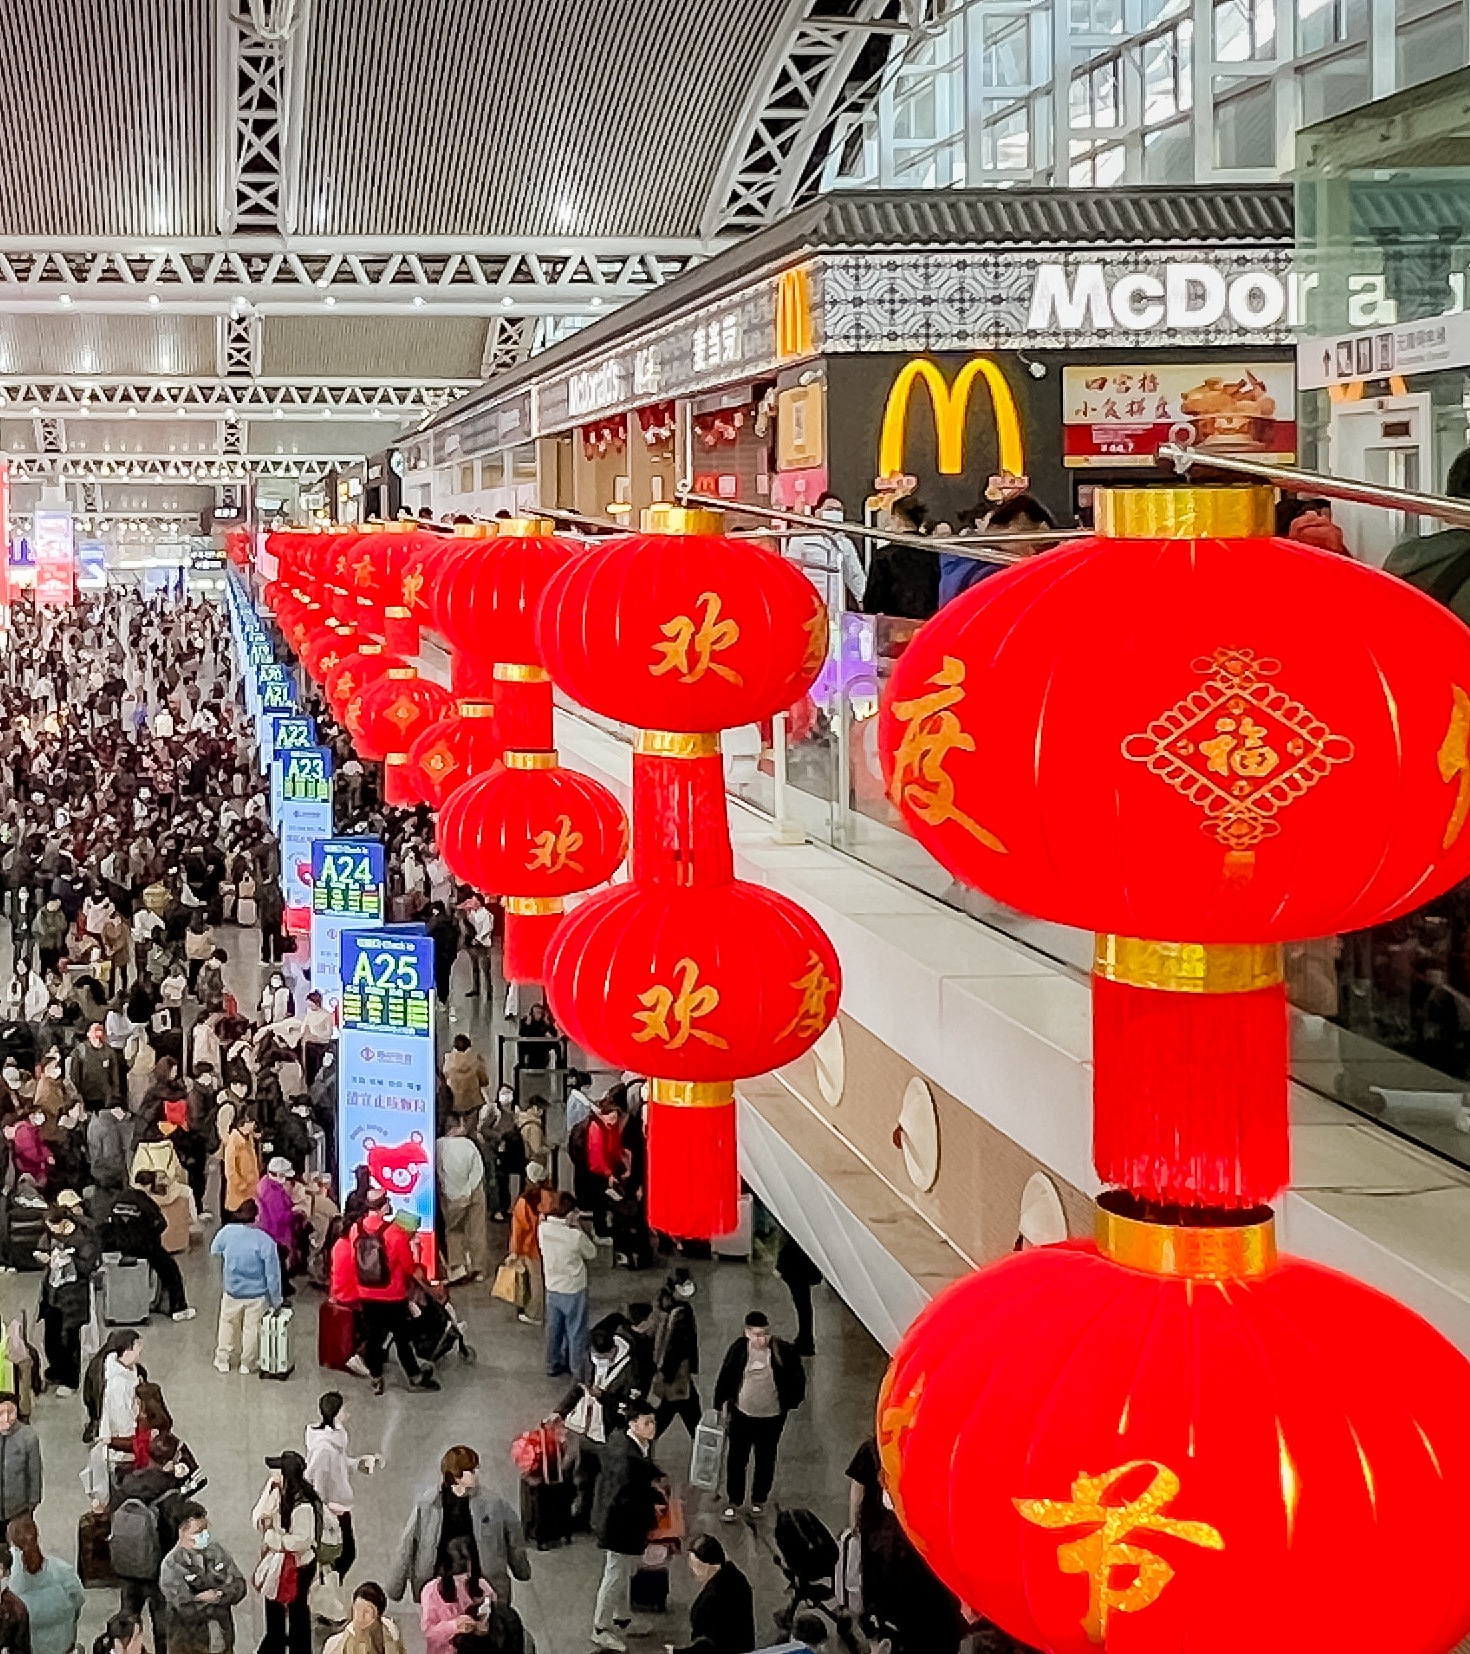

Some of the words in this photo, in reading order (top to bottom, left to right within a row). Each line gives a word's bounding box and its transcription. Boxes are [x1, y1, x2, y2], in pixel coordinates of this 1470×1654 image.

[648, 591, 744, 688] 欢
[277, 725, 308, 747] A22
[890, 654, 1010, 854] 度
[1198, 716, 1280, 778] 福
[288, 758, 324, 779] A23
[320, 854, 374, 885] A24
[524, 814, 585, 874] 欢
[352, 951, 419, 990] A25
[631, 957, 730, 1050] 欢
